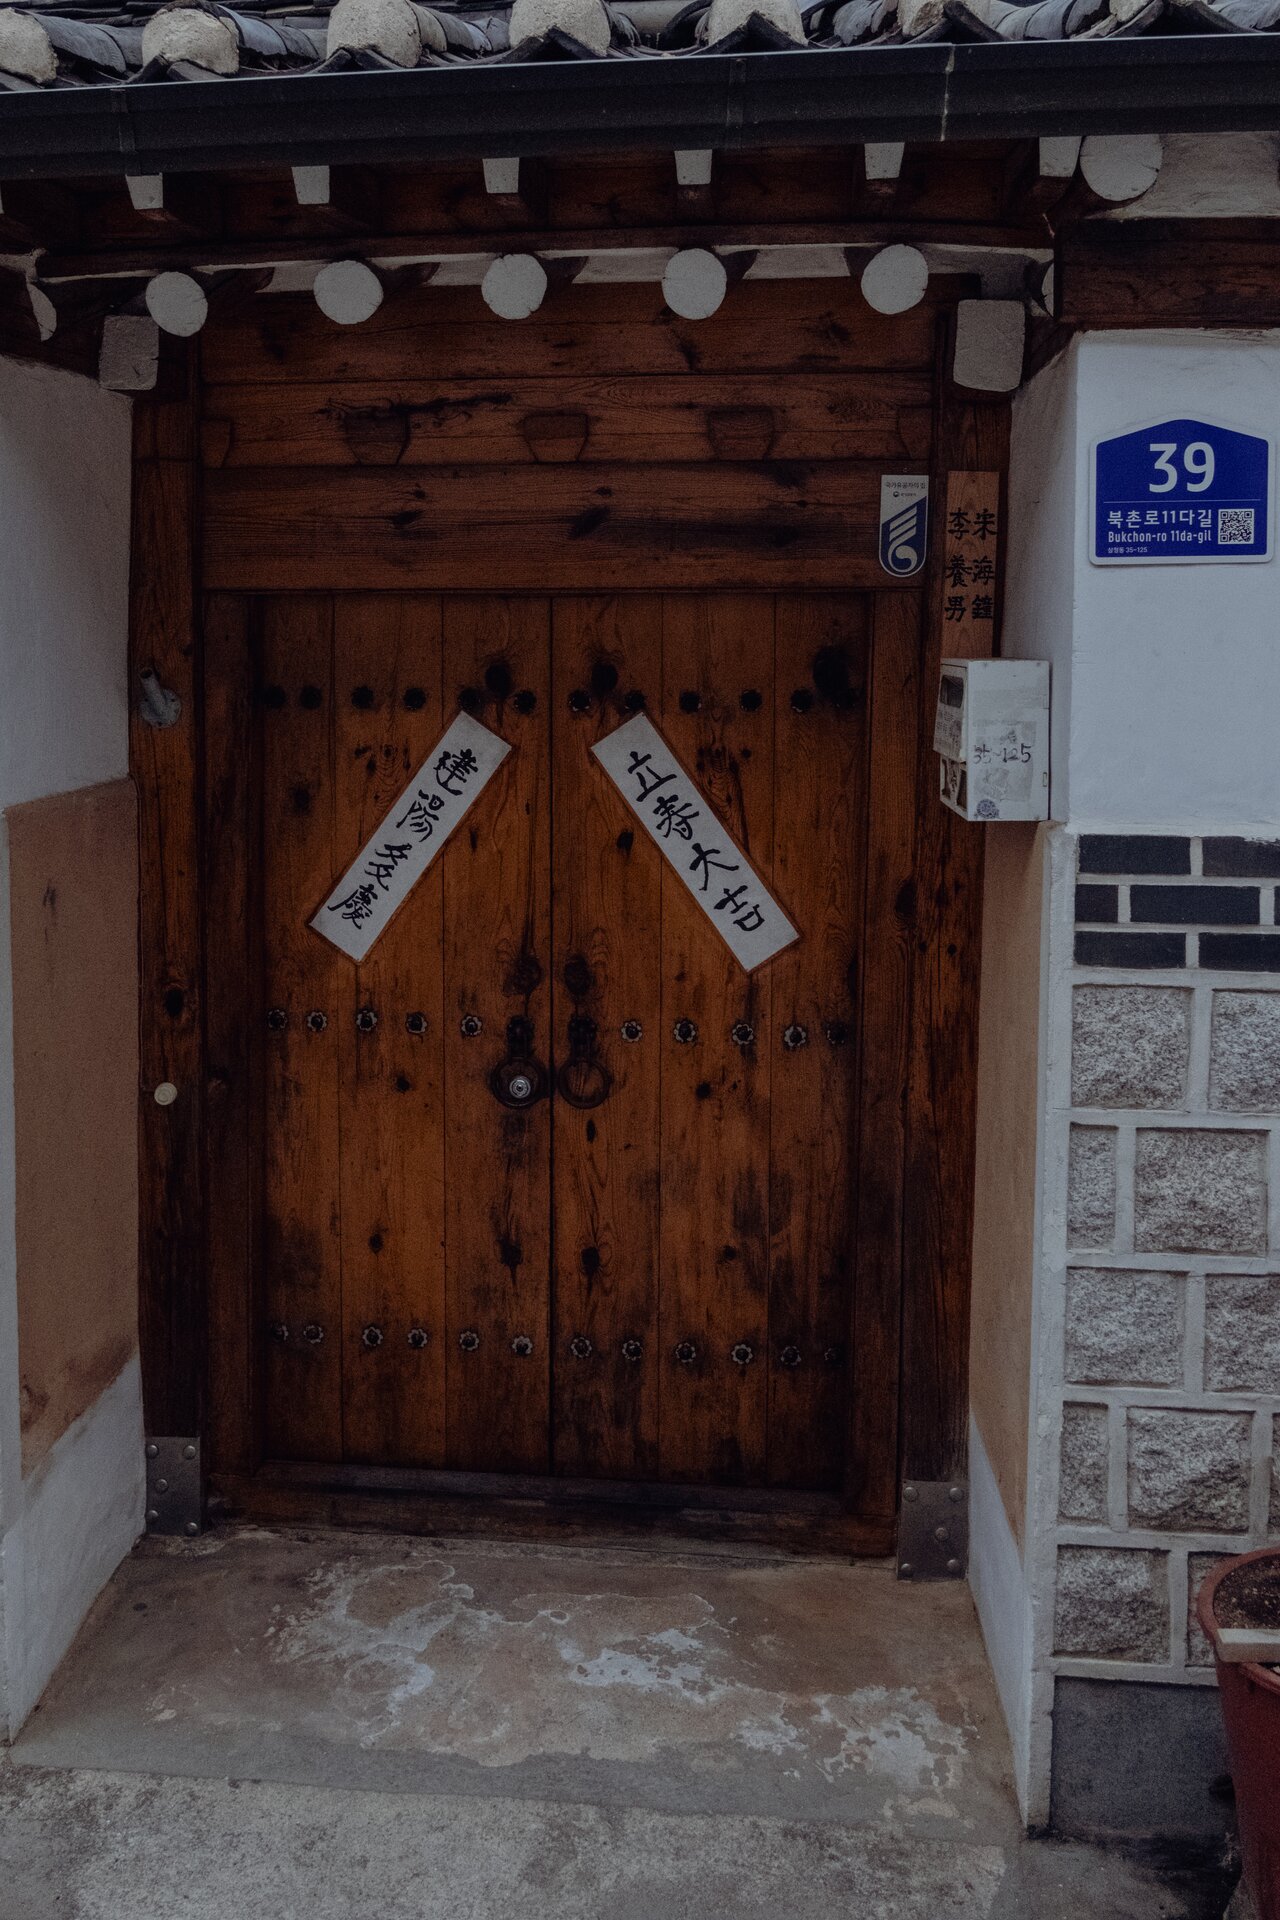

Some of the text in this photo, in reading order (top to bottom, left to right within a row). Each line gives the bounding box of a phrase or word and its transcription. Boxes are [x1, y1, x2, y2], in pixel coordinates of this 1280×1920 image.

[1148, 441, 1216, 493] 39
[1107, 509, 1212, 529] 북촌로11다길
[1108, 530, 1212, 544] Bukchon-ro 11da-gil
[627, 751, 766, 933] 立春大吉
